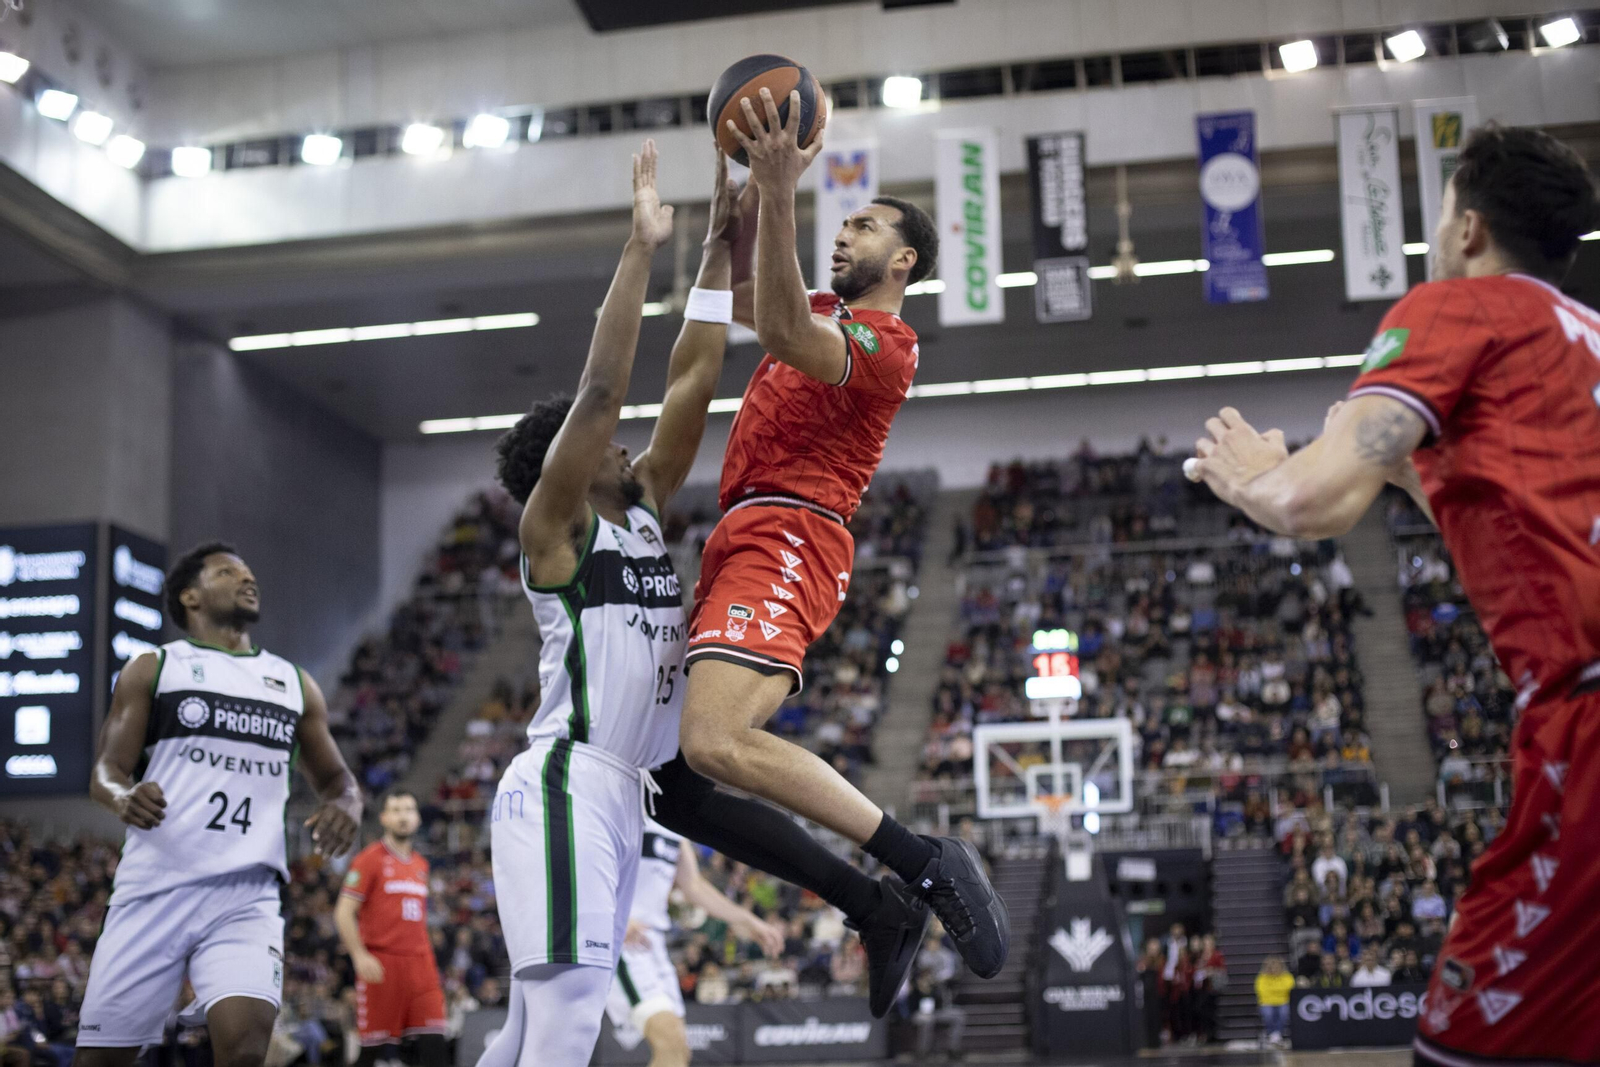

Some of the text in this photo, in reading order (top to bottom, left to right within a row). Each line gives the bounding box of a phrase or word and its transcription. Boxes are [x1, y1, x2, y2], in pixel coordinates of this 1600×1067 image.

[656, 665, 678, 705] 25
[214, 708, 295, 744] PROBITAS
[206, 791, 252, 835] 24
